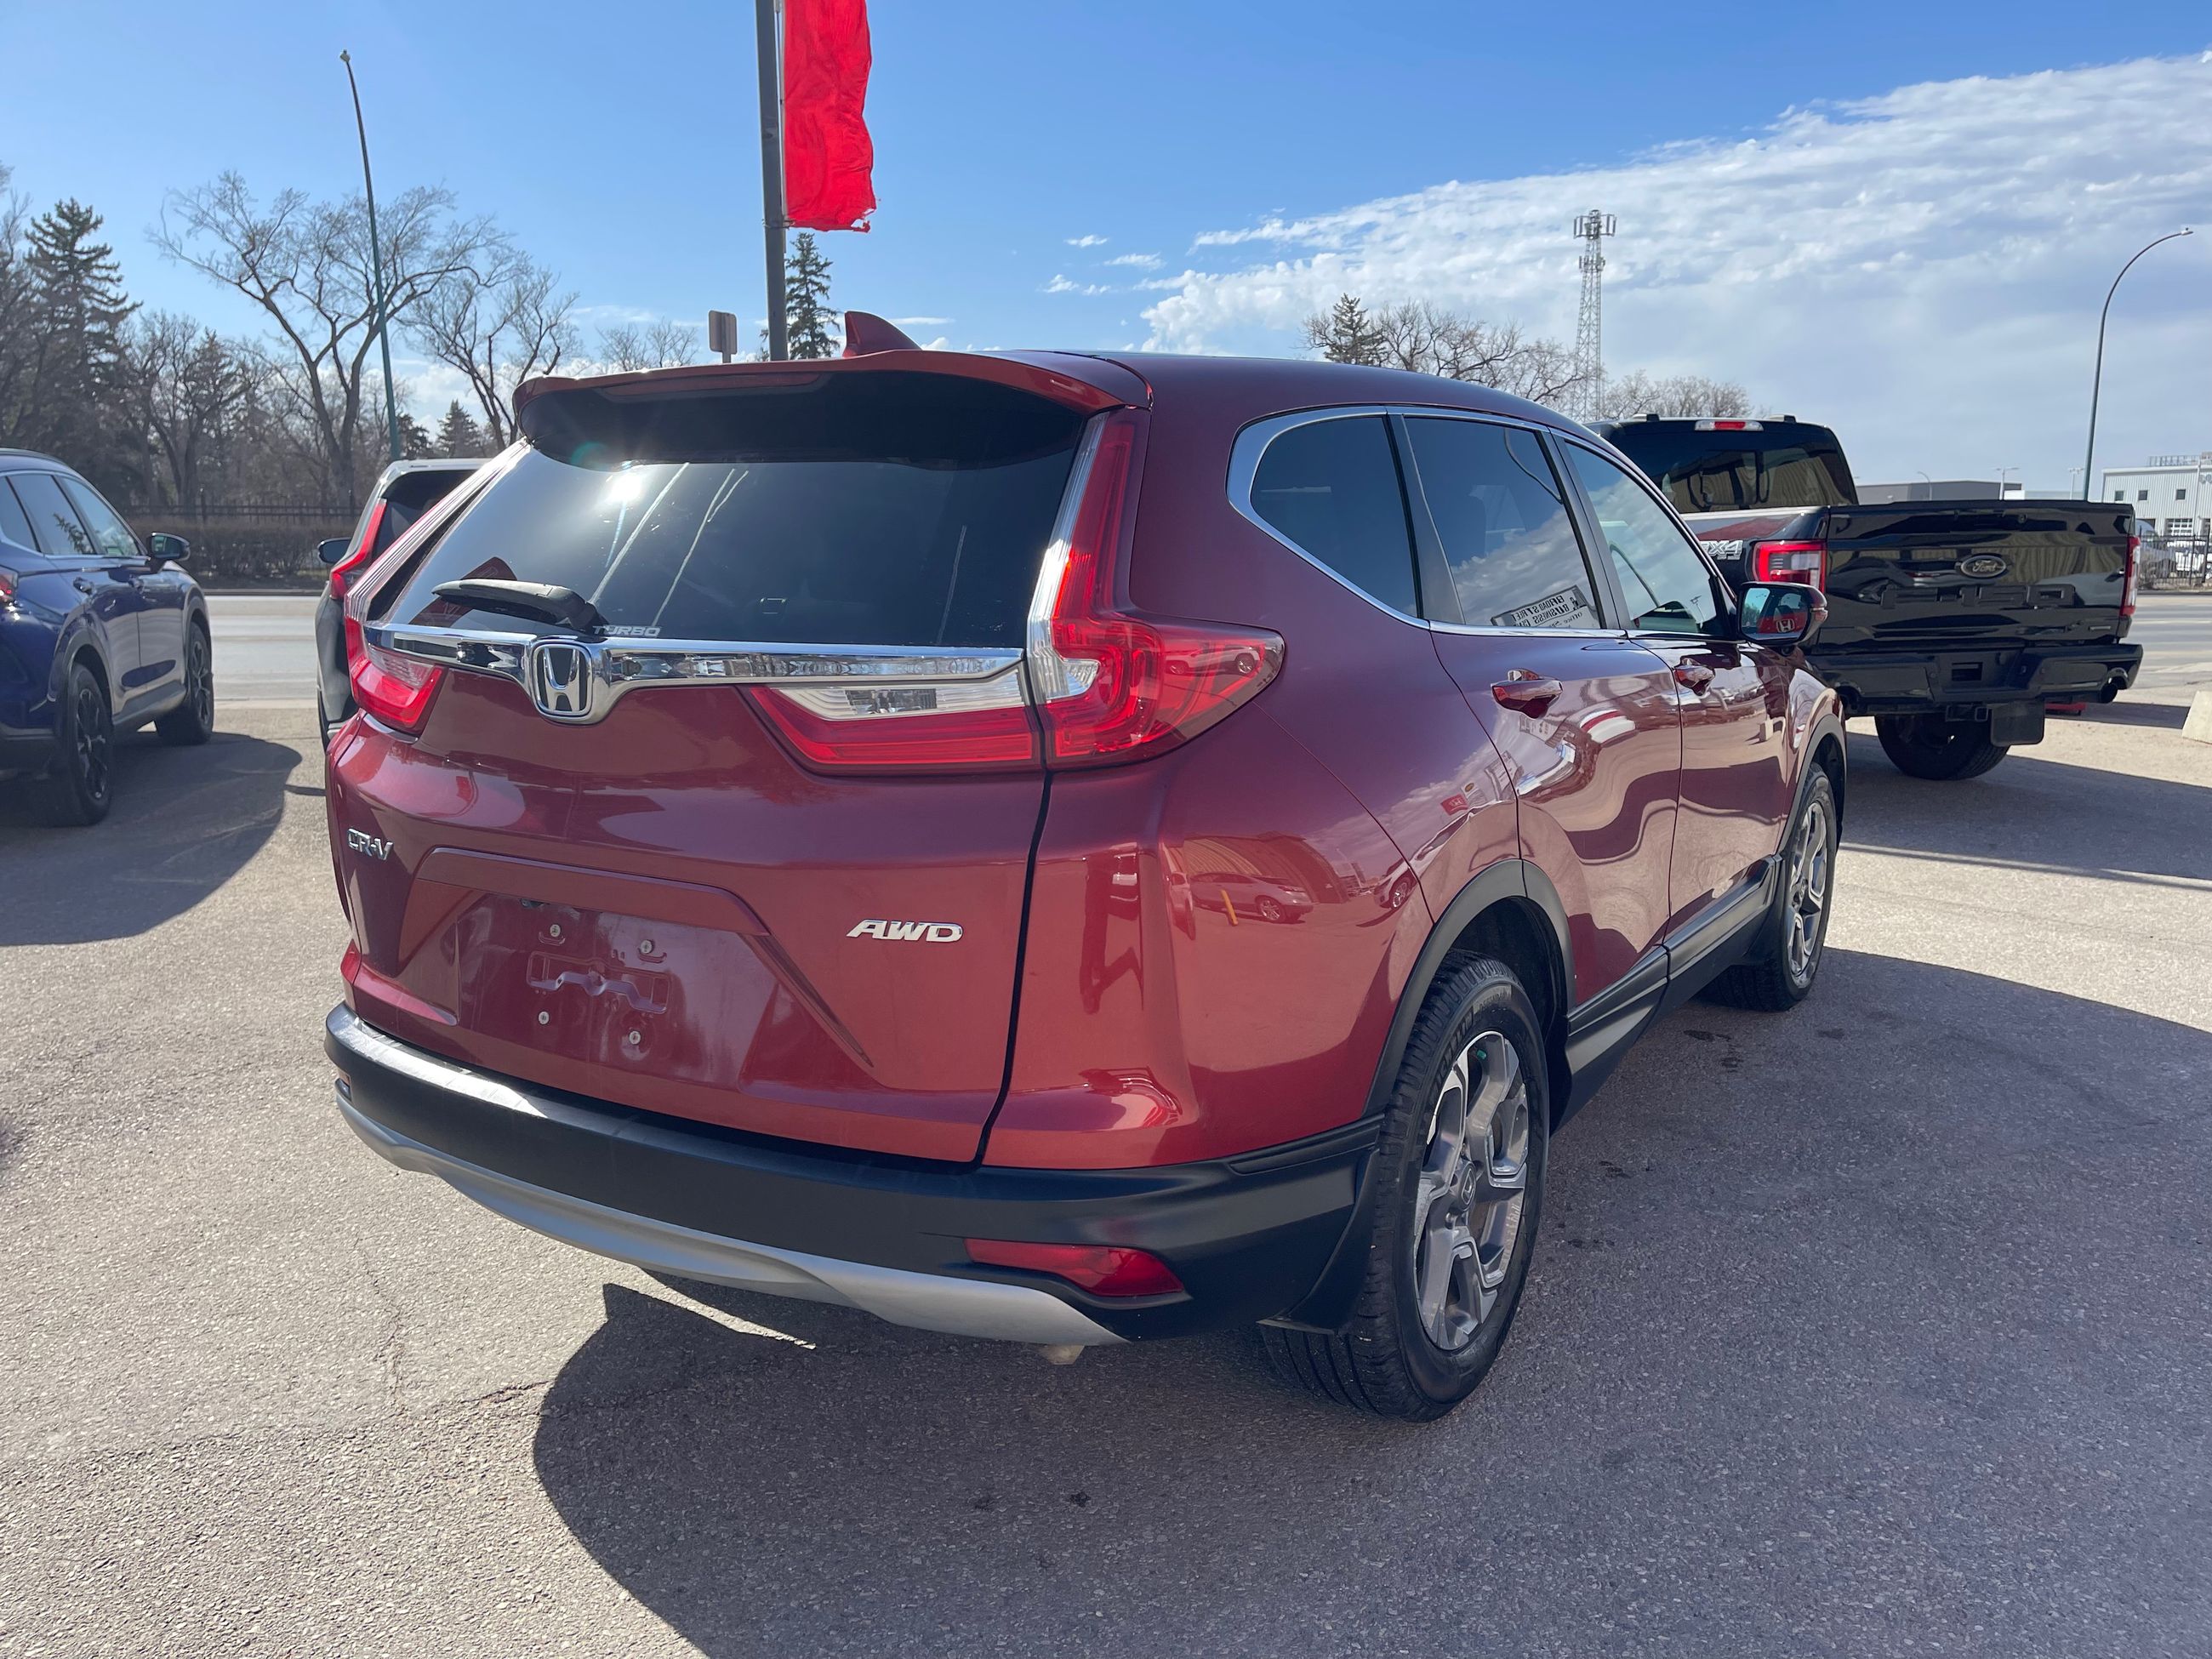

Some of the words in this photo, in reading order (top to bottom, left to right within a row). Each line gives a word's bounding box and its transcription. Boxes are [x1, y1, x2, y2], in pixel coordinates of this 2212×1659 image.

[1972, 558, 1999, 573] Ford
[592, 624, 662, 637] TURBO
[348, 828, 394, 860] CR-V
[846, 919, 964, 943] AWD
